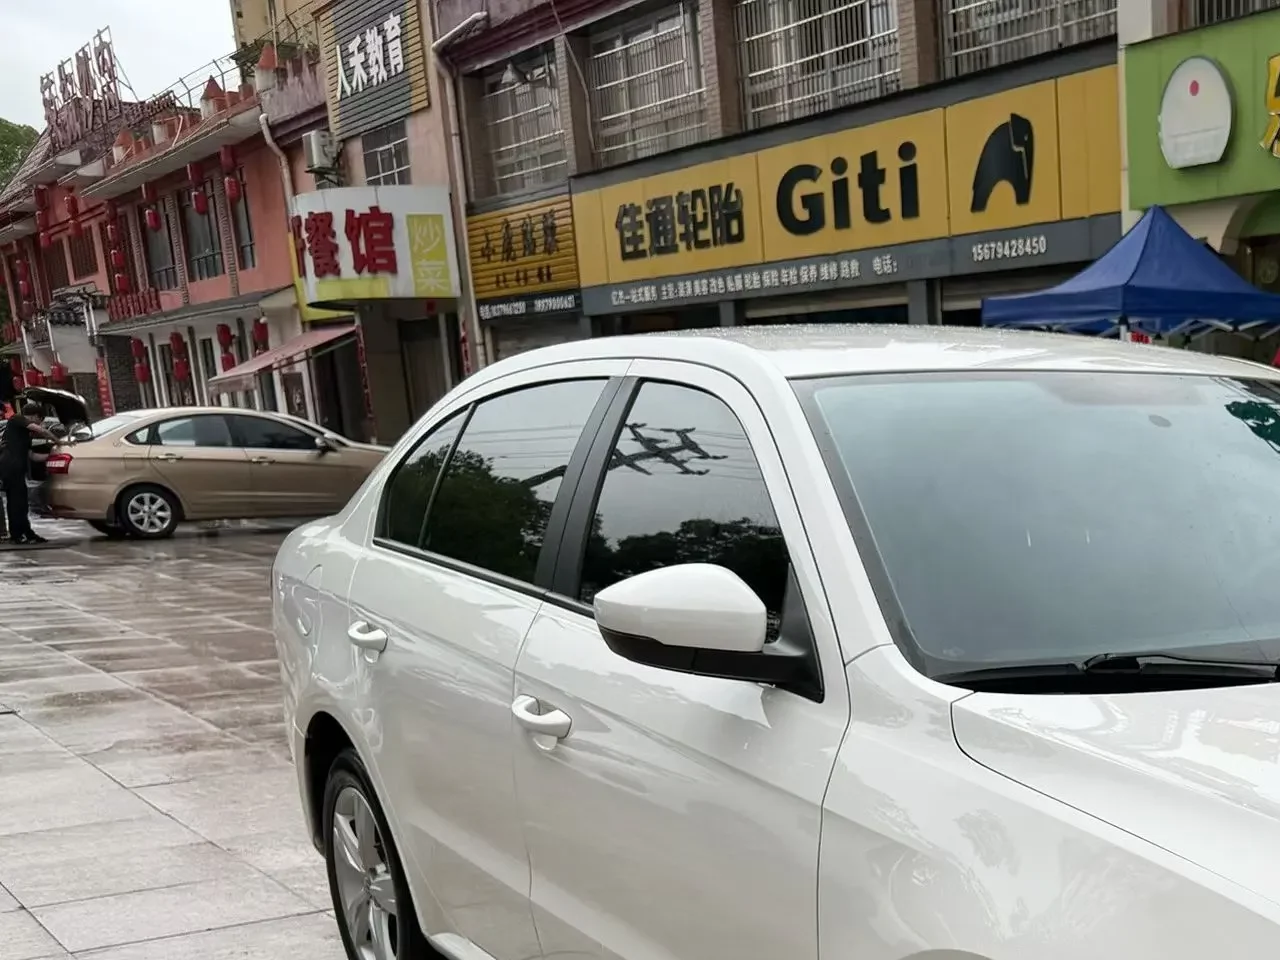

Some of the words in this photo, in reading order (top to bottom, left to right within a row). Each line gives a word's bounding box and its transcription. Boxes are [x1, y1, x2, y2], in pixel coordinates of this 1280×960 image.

[335, 12, 404, 101] 人禾教育
[615, 183, 745, 261] 佳通轮胎
[776, 142, 919, 235] Giti
[413, 218, 449, 292] 炒菜
